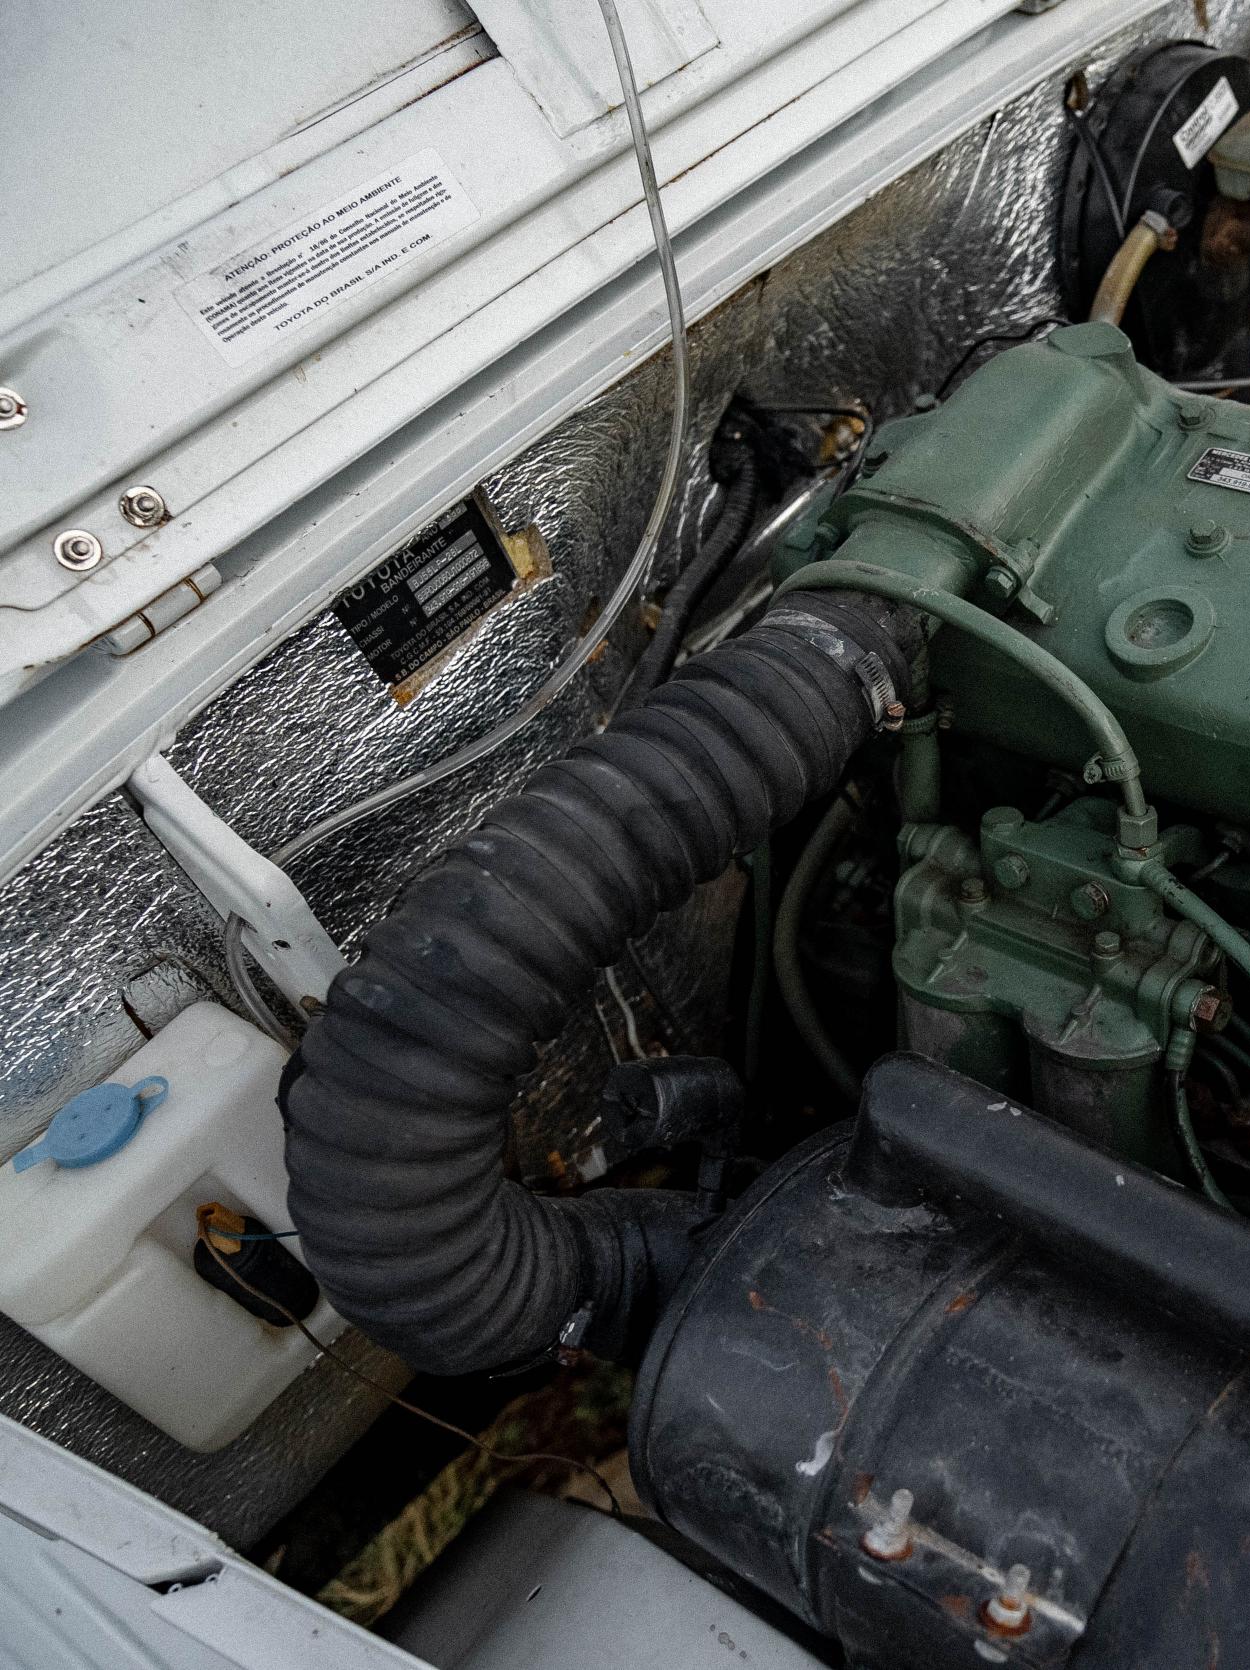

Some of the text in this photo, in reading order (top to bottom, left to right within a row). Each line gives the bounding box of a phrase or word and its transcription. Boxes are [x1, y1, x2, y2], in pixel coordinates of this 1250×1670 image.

[224, 253, 271, 281] ATENÇÃO:
[271, 222, 321, 254] PROTEÇÃO
[335, 201, 358, 216] MEIO
[359, 177, 401, 204] AMBIENTE
[338, 218, 364, 235] Conselho
[365, 203, 389, 219] Nacional
[398, 190, 412, 199] Meio
[413, 175, 438, 191] Ambiente
[205, 302, 237, 322] (CONAMA)
[315, 248, 329, 258] data
[274, 306, 313, 330] TOYOTA
[330, 275, 363, 297] BRASIL
[365, 264, 381, 276] S/A
[381, 253, 401, 266] IND.
[409, 233, 433, 249] COM.
[380, 536, 447, 594] BANDEIRANTE
[350, 619, 368, 635] TIPO
[370, 595, 399, 620] MODELO
[359, 625, 385, 649] CHASSI
[390, 638, 417, 660] TOYOTA
[415, 628, 427, 640] DO
[426, 611, 449, 632] BRASIL
[408, 659, 420, 671] DO
[419, 640, 443, 662] CAMPO
[445, 625, 460, 640] SÃO
[459, 608, 481, 628] PAULO
[482, 589, 506, 609] BRASIL
[367, 638, 393, 663] MOTOR
